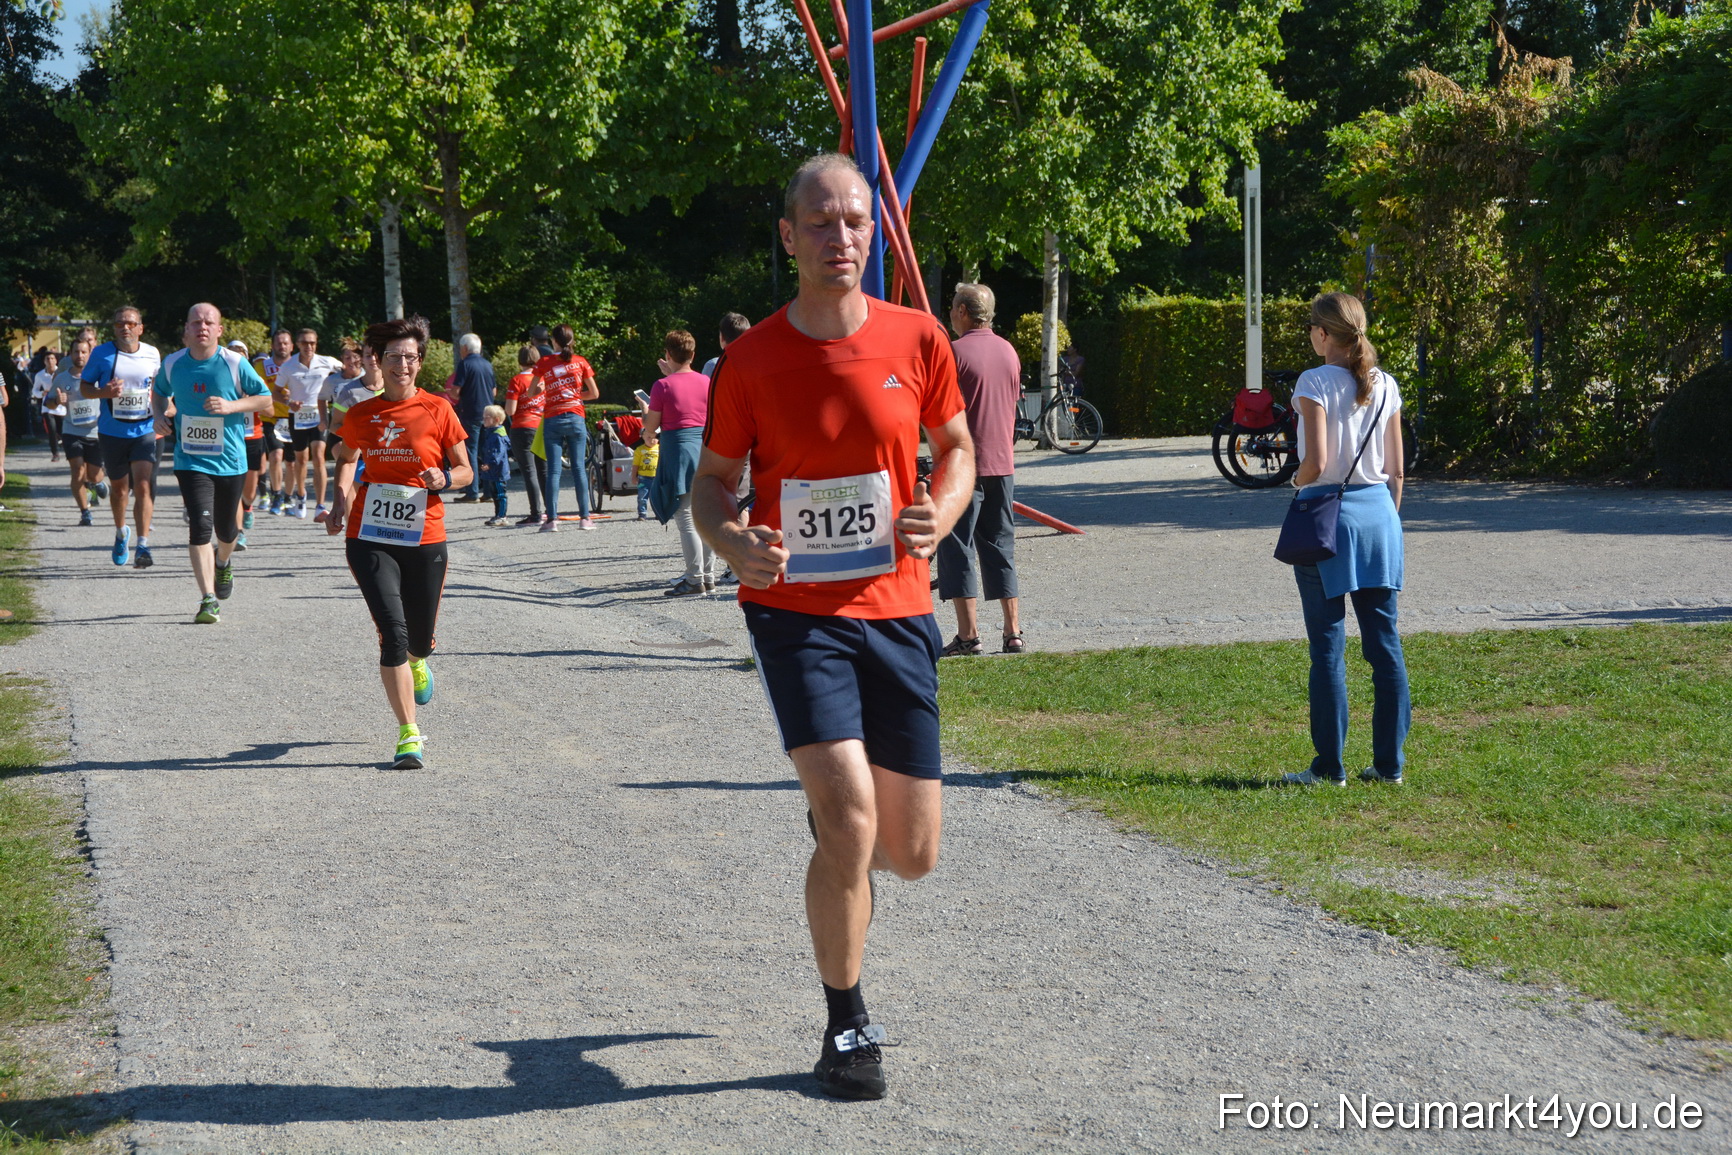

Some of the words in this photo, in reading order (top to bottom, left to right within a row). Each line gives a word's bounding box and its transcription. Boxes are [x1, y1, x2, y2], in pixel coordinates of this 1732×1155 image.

[118, 396, 143, 406] 2504
[73, 406, 93, 416] 3095
[298, 412, 317, 420] 2347
[186, 426, 217, 440] 2088
[366, 448, 414, 458] funrunners
[379, 455, 421, 463] neumarkt
[381, 488, 409, 499] BOCK
[811, 485, 860, 501] BOCK
[371, 499, 416, 522] 2182
[798, 503, 876, 539] 3125
[376, 528, 405, 539] Brigitte
[831, 540, 863, 549] Neumarkt
